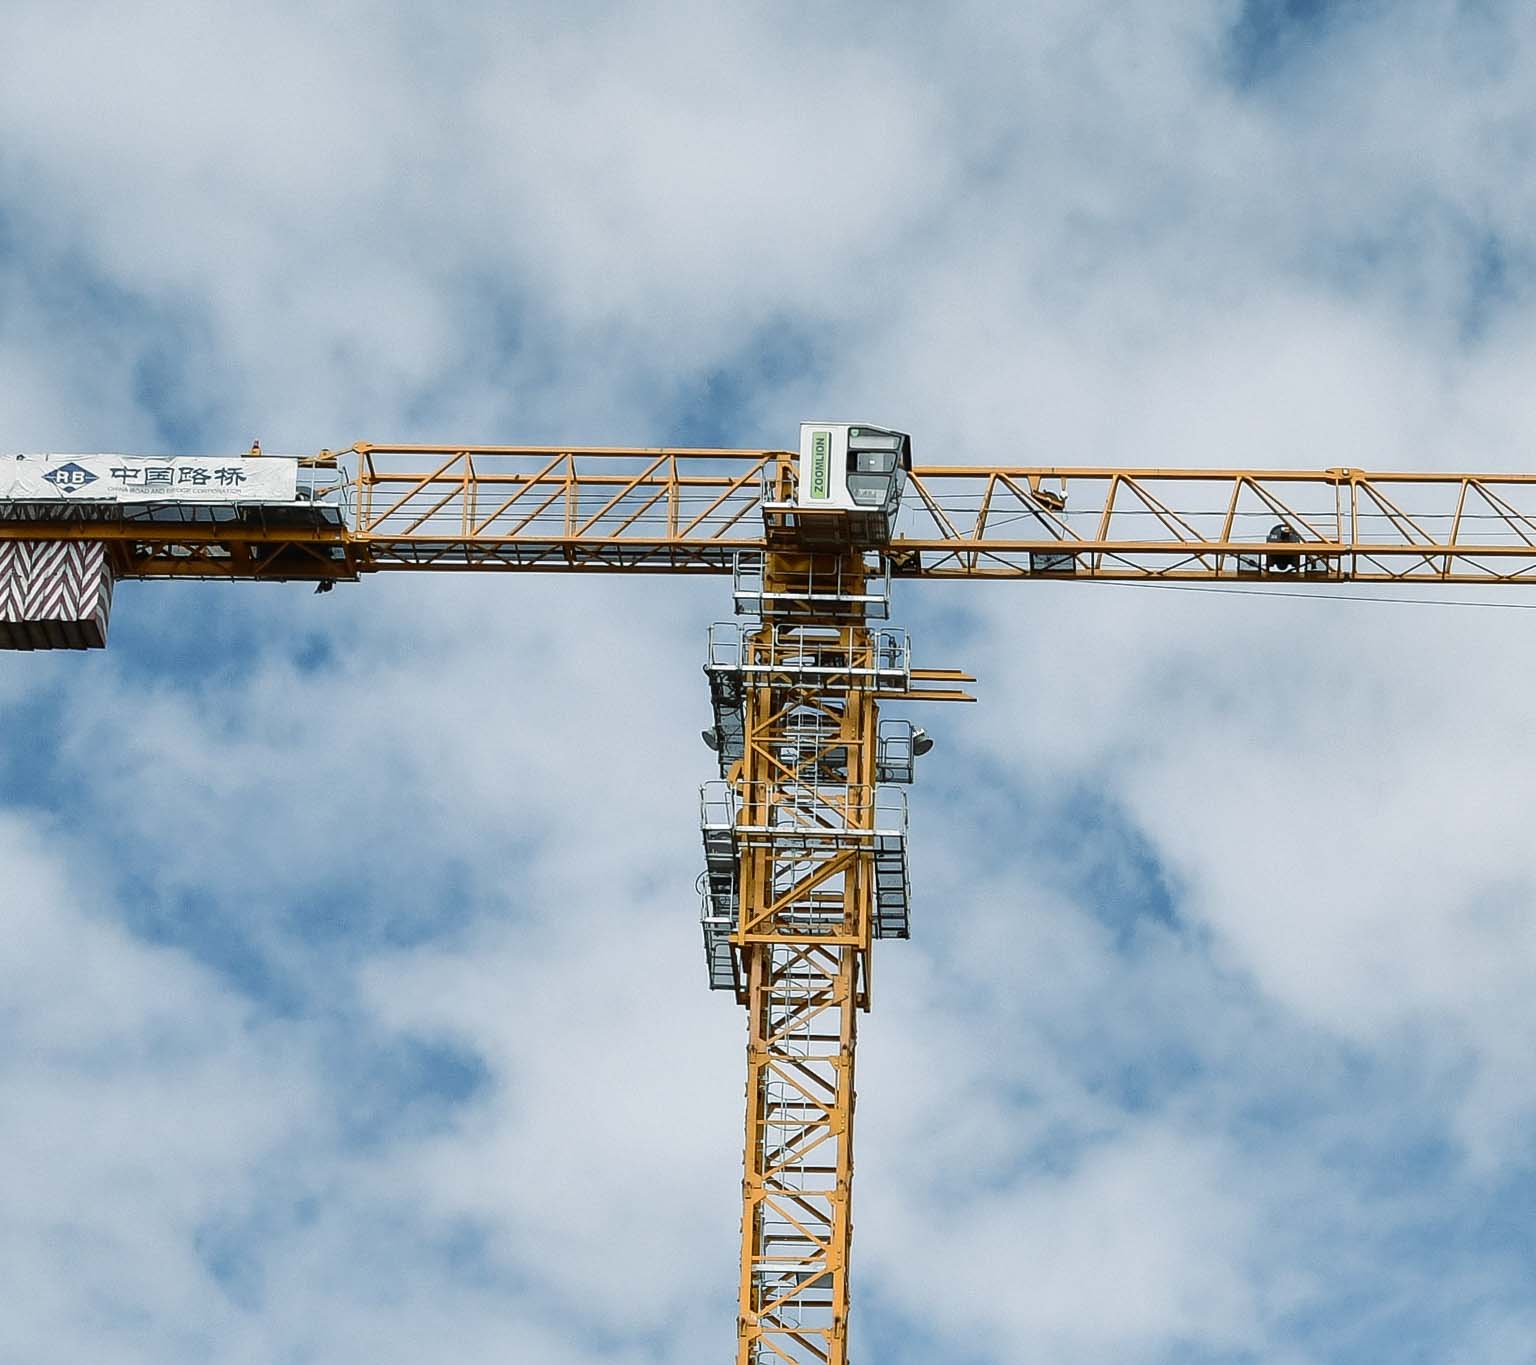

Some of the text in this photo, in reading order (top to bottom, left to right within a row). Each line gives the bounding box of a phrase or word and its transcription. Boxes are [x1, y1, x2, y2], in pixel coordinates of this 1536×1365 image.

[110, 465, 247, 487] 中国路桥
[814, 437, 825, 493] ZOOMLION
